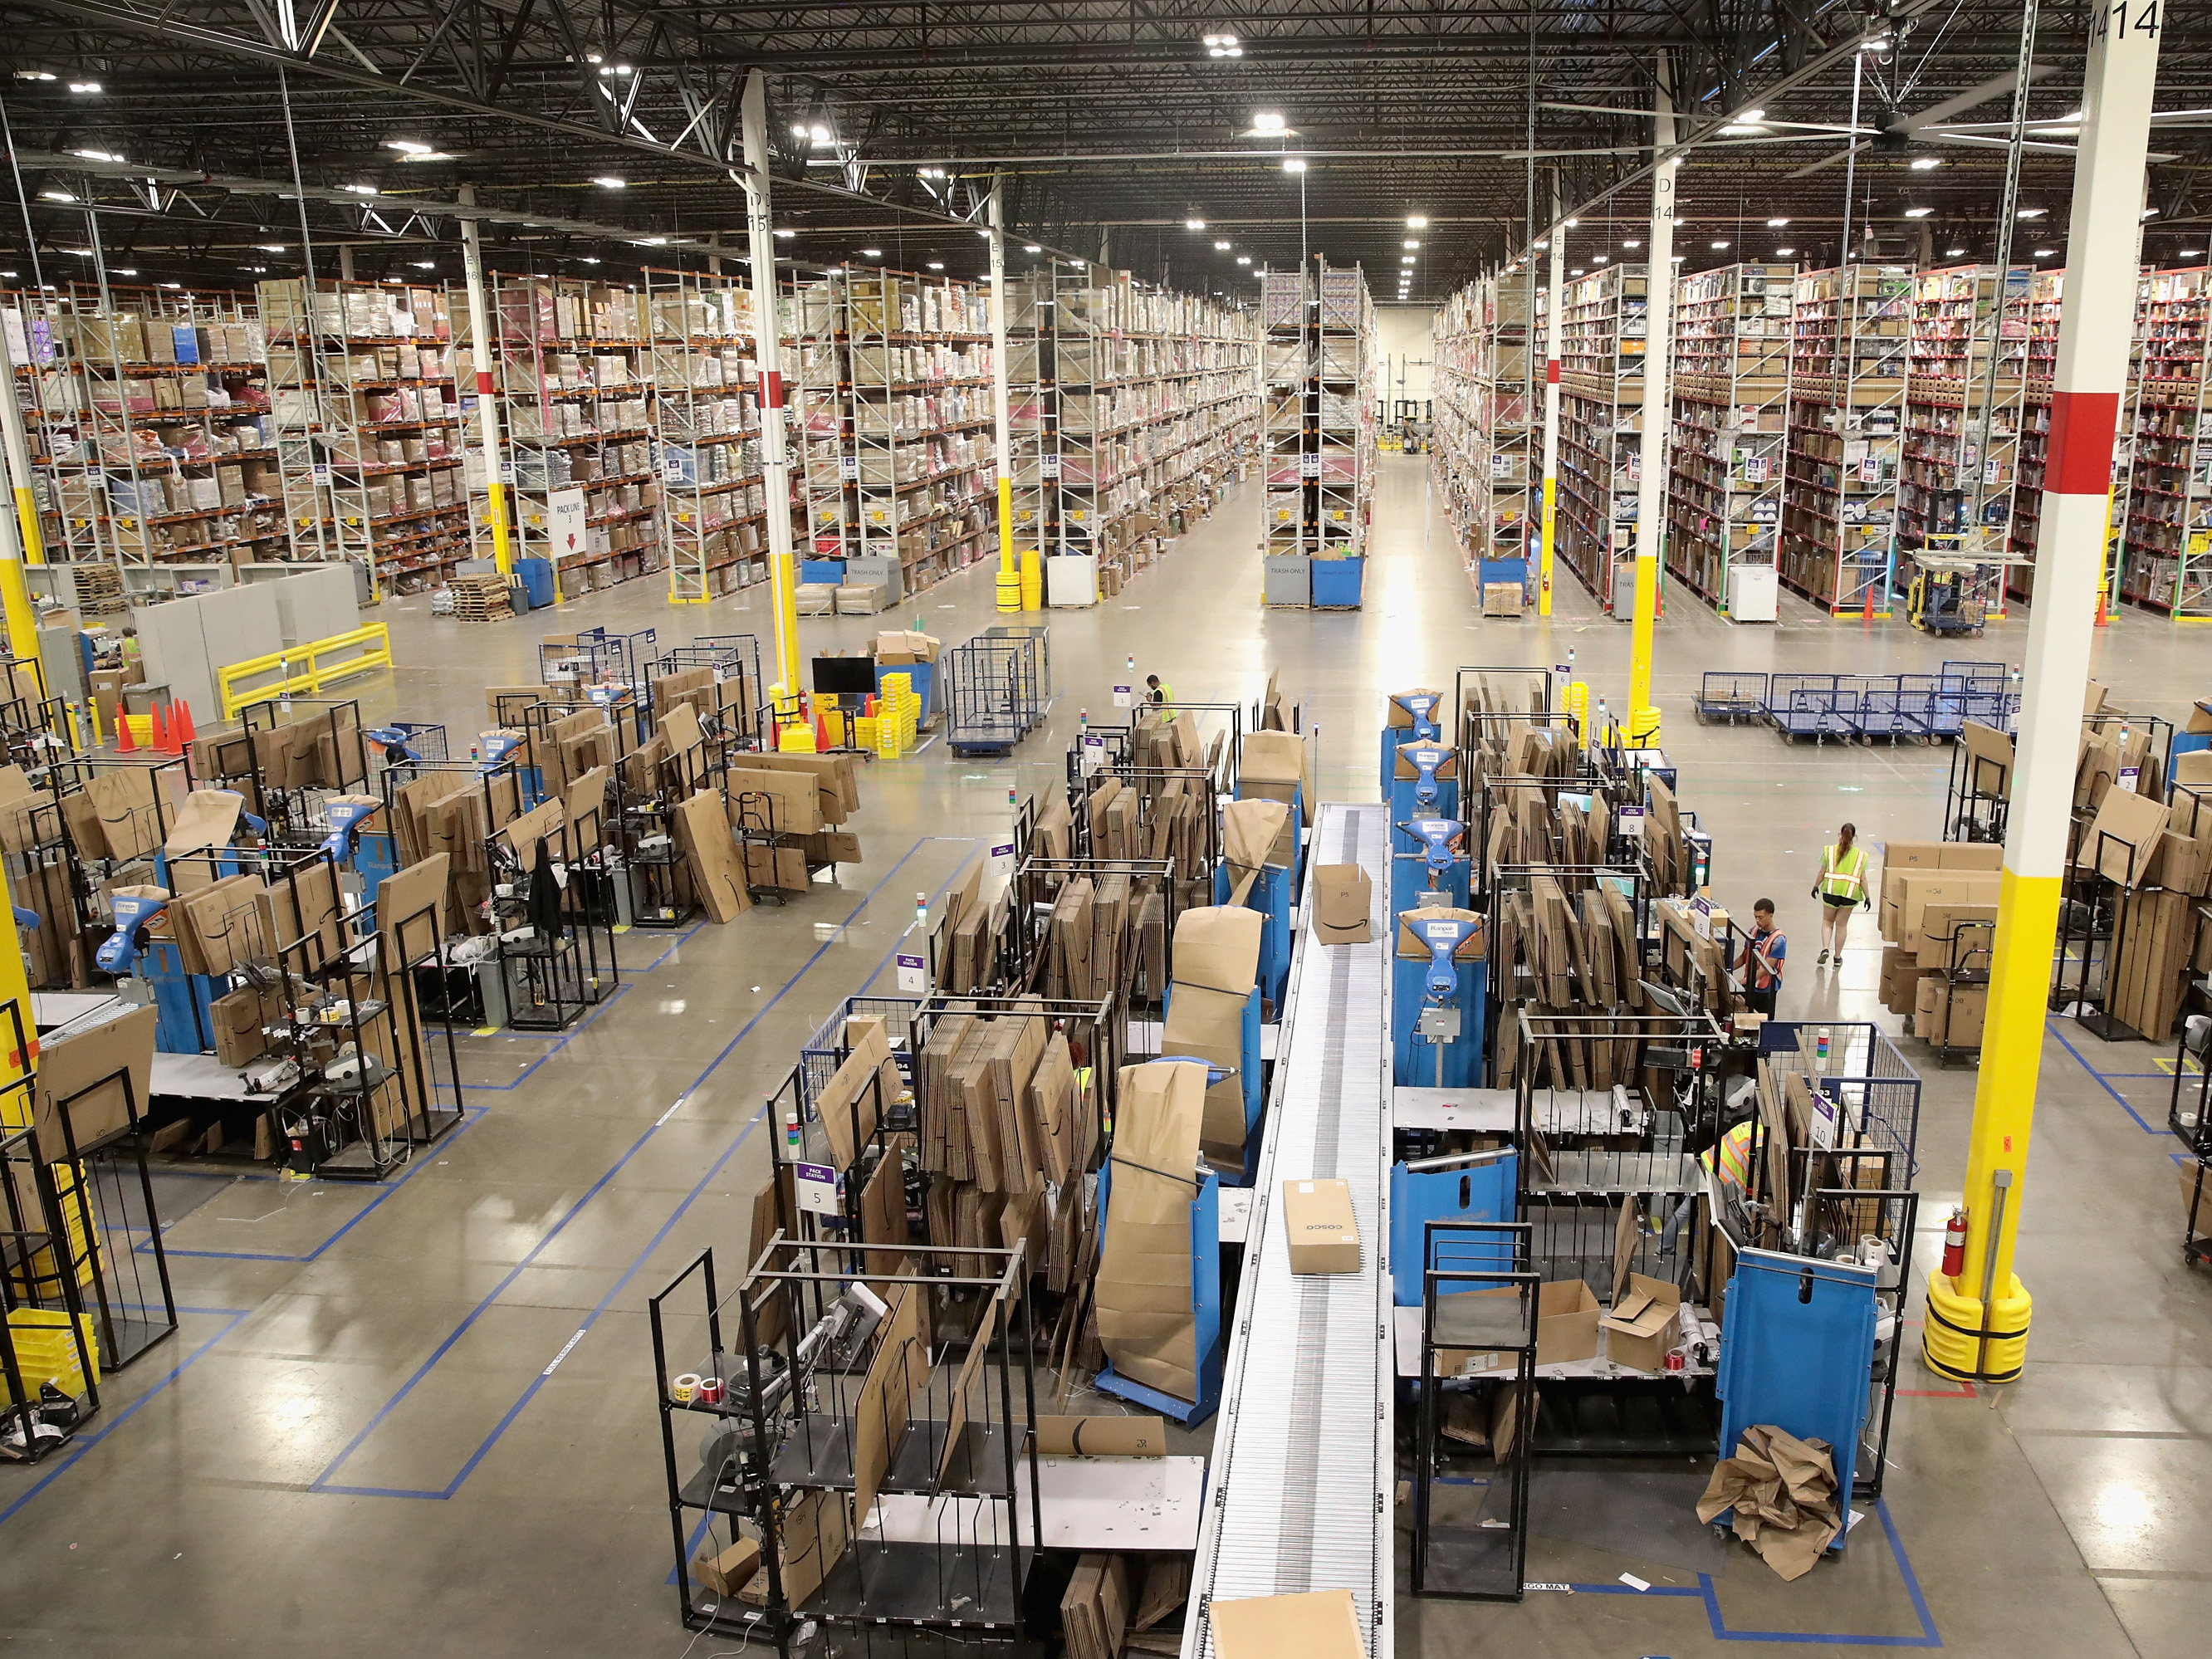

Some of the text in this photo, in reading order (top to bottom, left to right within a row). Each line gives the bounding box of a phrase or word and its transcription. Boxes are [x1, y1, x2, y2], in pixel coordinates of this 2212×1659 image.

[2112, 1, 2160, 39] 14
[2091, 5, 2109, 47] 14
[1659, 179, 1671, 193] D
[1656, 206, 1673, 219] 14
[749, 218, 766, 232] 15
[1555, 236, 1562, 245] E
[992, 243, 999, 252] E
[467, 256, 473, 264] E
[1553, 252, 1564, 261] 14
[991, 259, 1002, 267] 15
[467, 271, 477, 280] 16
[557, 502, 580, 515] PACK LINE
[568, 515, 572, 523] 3
[1629, 825, 1634, 833] 8
[1699, 923, 1703, 932] 9
[908, 976, 913, 985] 4
[1816, 1126, 1825, 1143] 10
[814, 1193, 821, 1203] 5
[545, 1358, 560, 1374] FULL
[1137, 1439, 1147, 1448] P5
